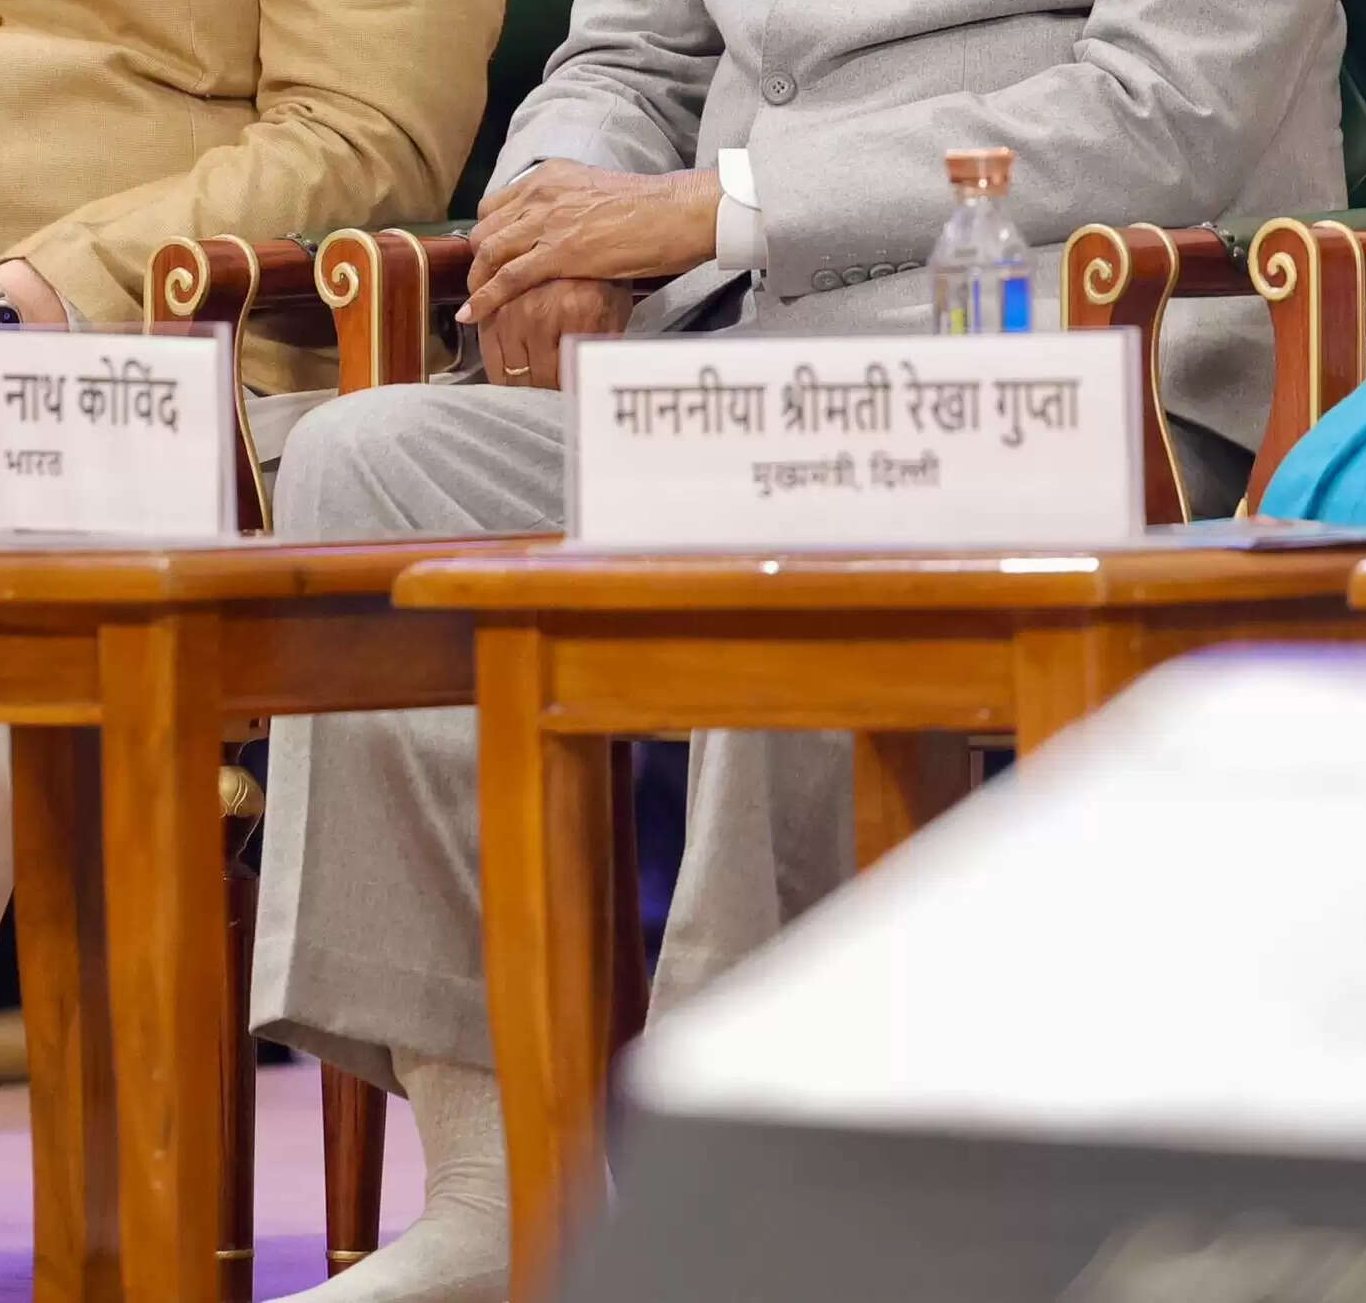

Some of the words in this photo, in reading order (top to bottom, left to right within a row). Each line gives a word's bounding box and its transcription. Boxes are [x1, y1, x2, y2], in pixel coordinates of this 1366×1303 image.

[4, 374, 66, 422] नाथ
[78, 357, 180, 432] कोविंद
[612, 366, 765, 434] माननीया
[781, 364, 891, 432] श्रीमती
[903, 361, 980, 432] रेखा
[995, 380, 1078, 448] गुप्ता
[5, 450, 62, 476] भारत
